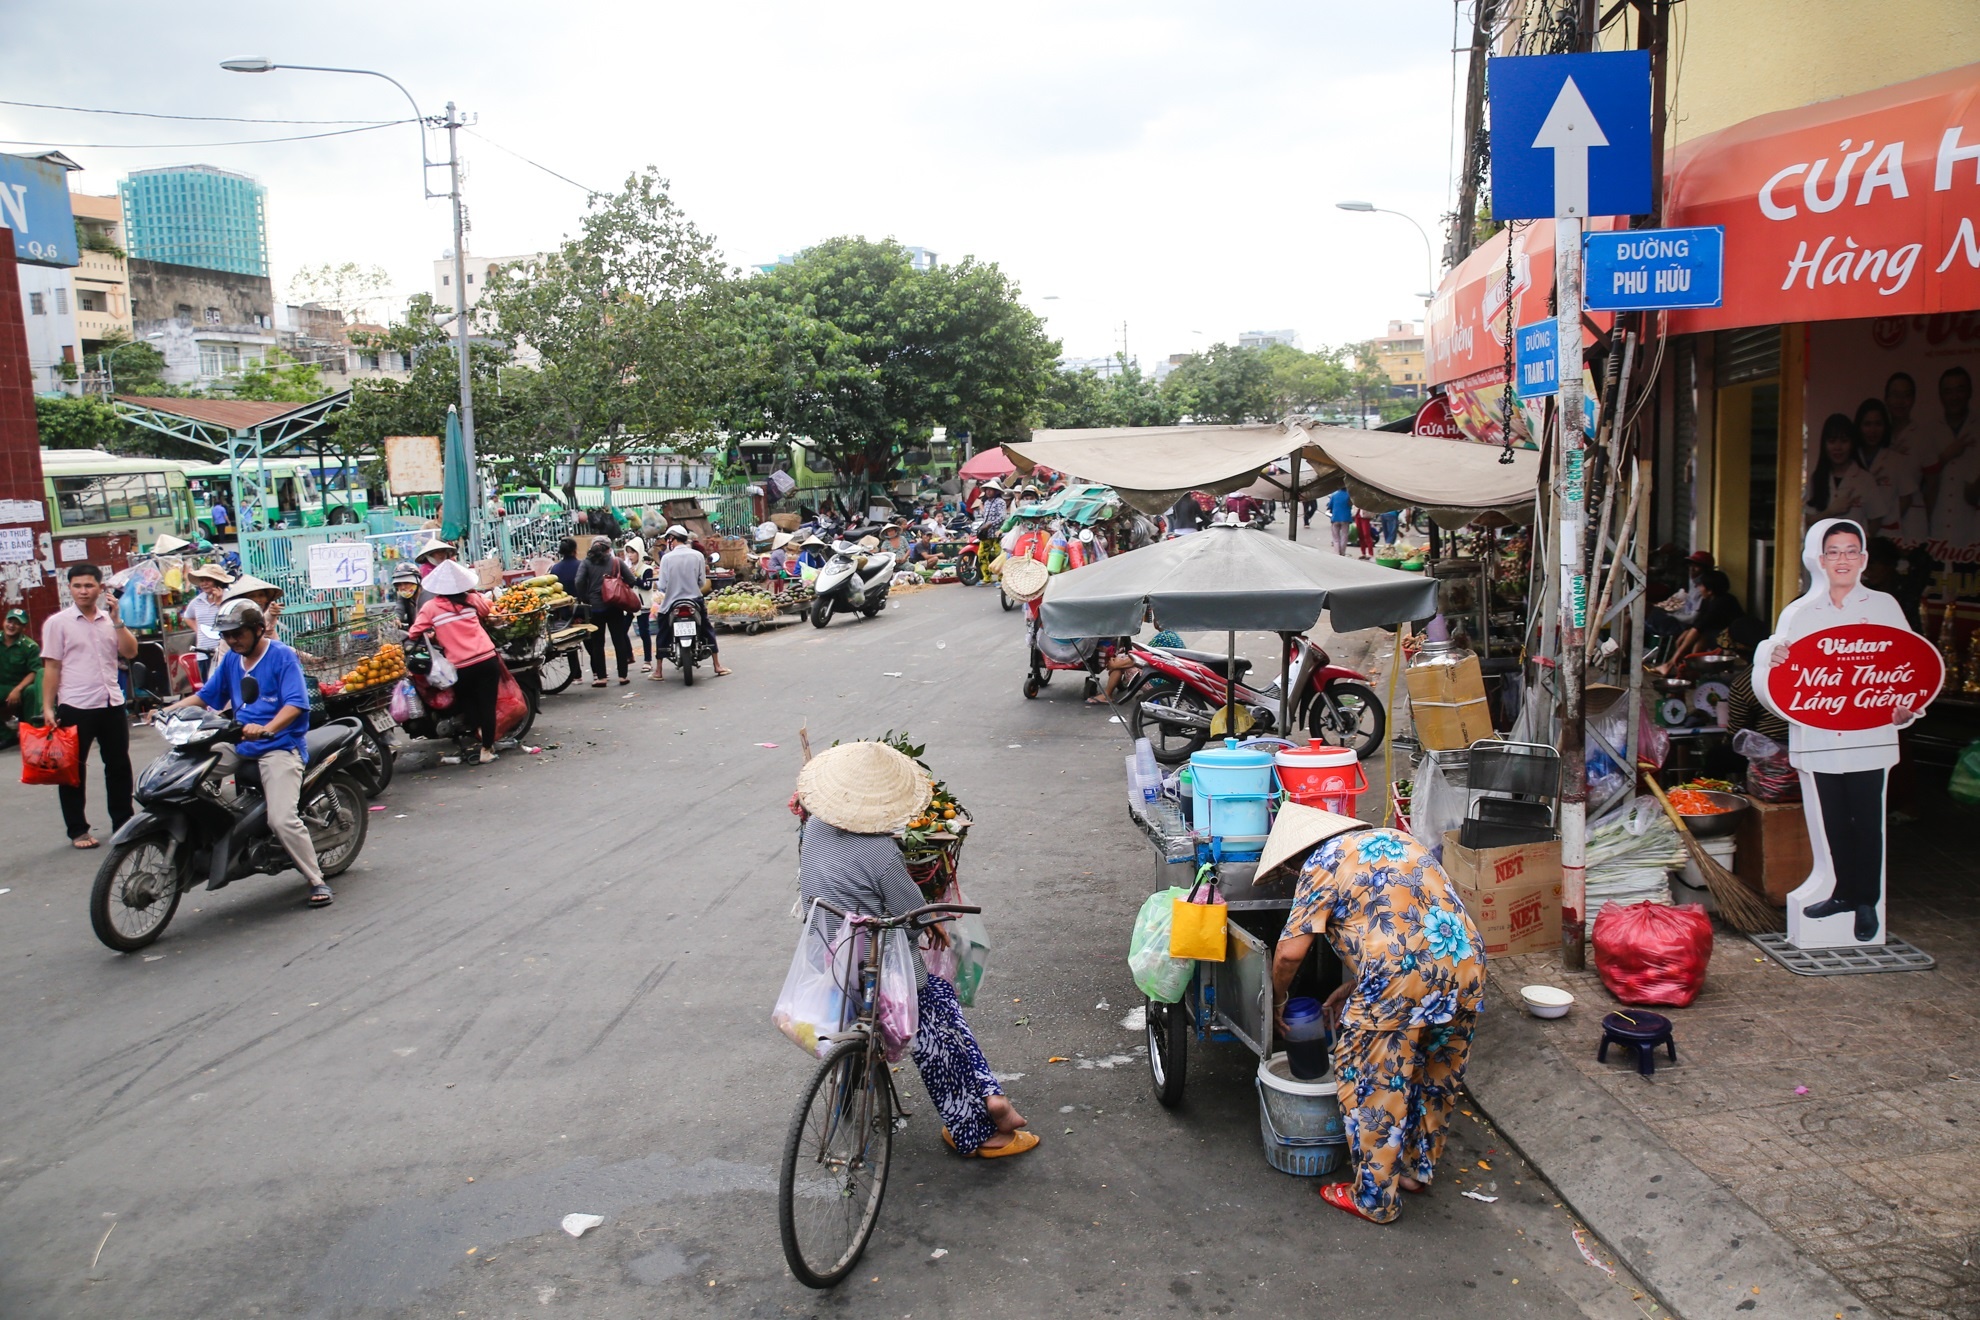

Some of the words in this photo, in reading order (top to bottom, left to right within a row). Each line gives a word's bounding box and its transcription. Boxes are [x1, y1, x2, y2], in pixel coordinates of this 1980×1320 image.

[1758, 138, 1910, 221] CỬA
[28, 240, 58, 260] Q.6
[1616, 237, 1690, 261] ĐƯỜNG
[1781, 235, 1923, 296] Hàng
[1613, 265, 1648, 295] PHÚ
[1655, 263, 1691, 293] HỮU
[1525, 329, 1551, 352] ĐƯỜNG
[1524, 361, 1545, 385] TRANG
[1417, 421, 1441, 436] CỬA
[335, 556, 368, 585] 15
[1817, 637, 1893, 655] Vistar
[1851, 662, 1915, 687] Thuốc
[1789, 691, 1847, 716] Láng
[1494, 856, 1524, 884] NET
[1510, 900, 1543, 933] NET
